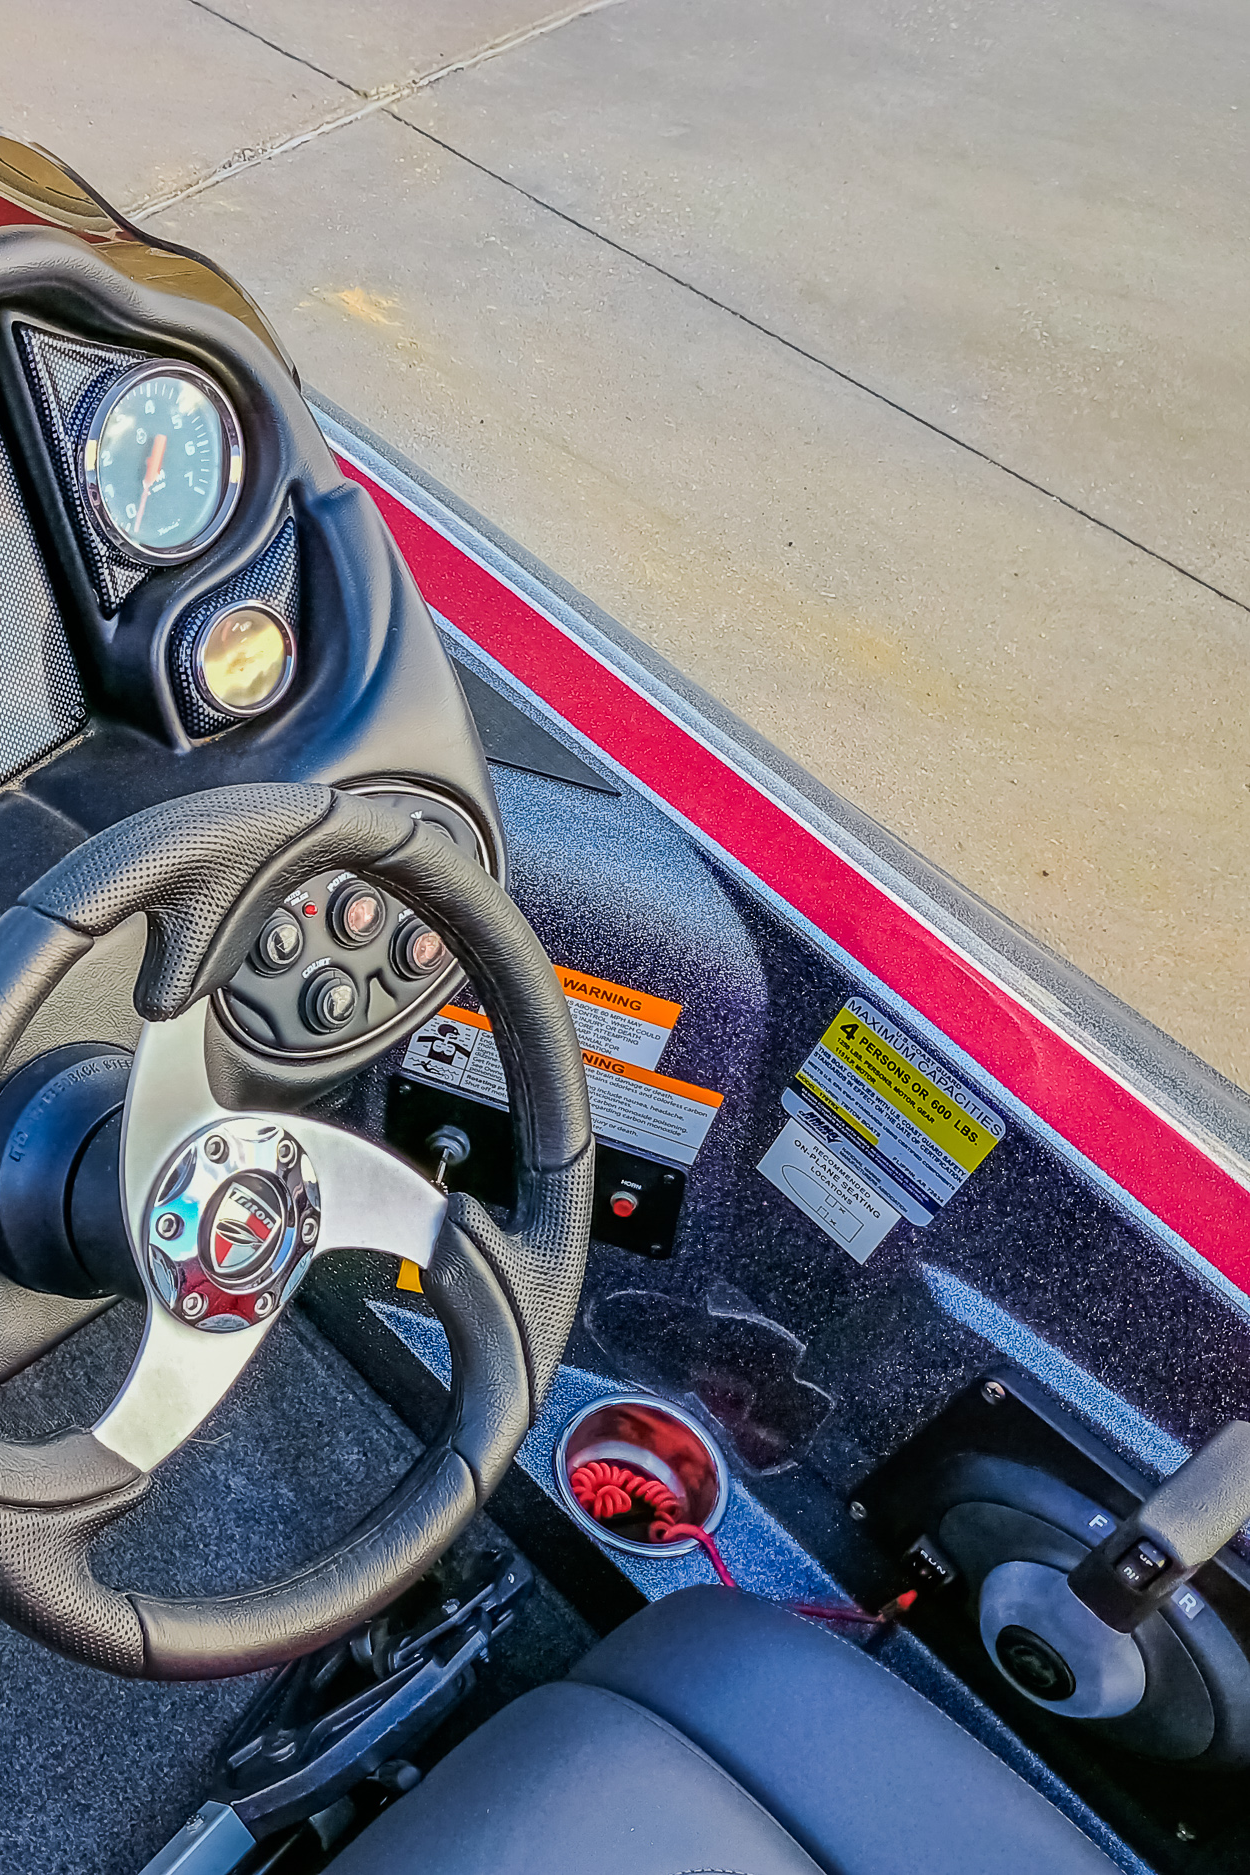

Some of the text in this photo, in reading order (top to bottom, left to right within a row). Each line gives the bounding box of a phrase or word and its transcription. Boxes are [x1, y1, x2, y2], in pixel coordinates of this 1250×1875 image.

[145, 400, 155, 414] 4
[171, 415, 183, 429] 5
[185, 441, 195, 456] 6
[101, 450, 113, 467] 2
[184, 471, 194, 487] 7
[126, 503, 137, 519] 0
[564, 978, 641, 1011] WARNING
[574, 1002, 599, 1014] ABOVE
[610, 1013, 626, 1023] MPH
[627, 1019, 643, 1028] MAY
[578, 1016, 605, 1027] INJURY
[605, 1024, 617, 1032] OR
[574, 1020, 594, 1031] FORE
[594, 1028, 639, 1045] ATTEMPTING
[611, 1020, 635, 1032] WHICH
[635, 1028, 661, 1040] COULD
[604, 1042, 620, 1051] FOR
[475, 1052, 498, 1062] dizzine
[582, 1052, 625, 1074] NING
[484, 1066, 503, 1076] Owne
[848, 1000, 916, 1061] MAXIMUM
[918, 1061, 1002, 1136] CAPACITIES
[855, 1064, 876, 1084] MOTOR
[910, 1044, 936, 1066] COAST
[936, 1066, 962, 1090] GUARD
[615, 1077, 643, 1089] damage
[839, 1021, 978, 1146] 4 PERSONS OR 600 LBS.
[597, 1087, 622, 1099] include
[609, 1081, 638, 1094] odorless
[638, 1091, 653, 1099] and
[653, 1096, 683, 1109] colorless
[683, 1106, 708, 1118] carbon
[593, 1098, 617, 1109] carbon
[818, 1046, 831, 1060] THIS
[830, 1057, 847, 1073] BOAT
[846, 1071, 875, 1098] COMPLIES
[875, 1095, 891, 1111] WITH
[901, 1119, 922, 1138] COAST
[921, 1137, 943, 1157] GUARD
[942, 1155, 966, 1176] SAFETY
[841, 1101, 862, 1120] TRITON
[893, 1086, 916, 1109] MOTOR,
[917, 1106, 935, 1124] GEAR
[591, 1117, 608, 1127] njury
[622, 1114, 646, 1125] carbon
[813, 1051, 847, 1081] STANDARDS
[846, 1079, 854, 1087] IN
[853, 1085, 875, 1105] EFFECT
[874, 1104, 885, 1114] ON
[884, 1112, 897, 1125] THE
[895, 1122, 912, 1138] DATE
[911, 1136, 921, 1144] OF
[920, 1144, 963, 1183] CERTIFICATION
[794, 1139, 881, 1219] ON-PLANE SEATING
[813, 1146, 871, 1198] RECOMMENDED
[810, 1166, 853, 1205] LOCATIONS
[229, 1189, 275, 1229] Triton
[1089, 1514, 1108, 1528] F
[1178, 1593, 1197, 1612] R
